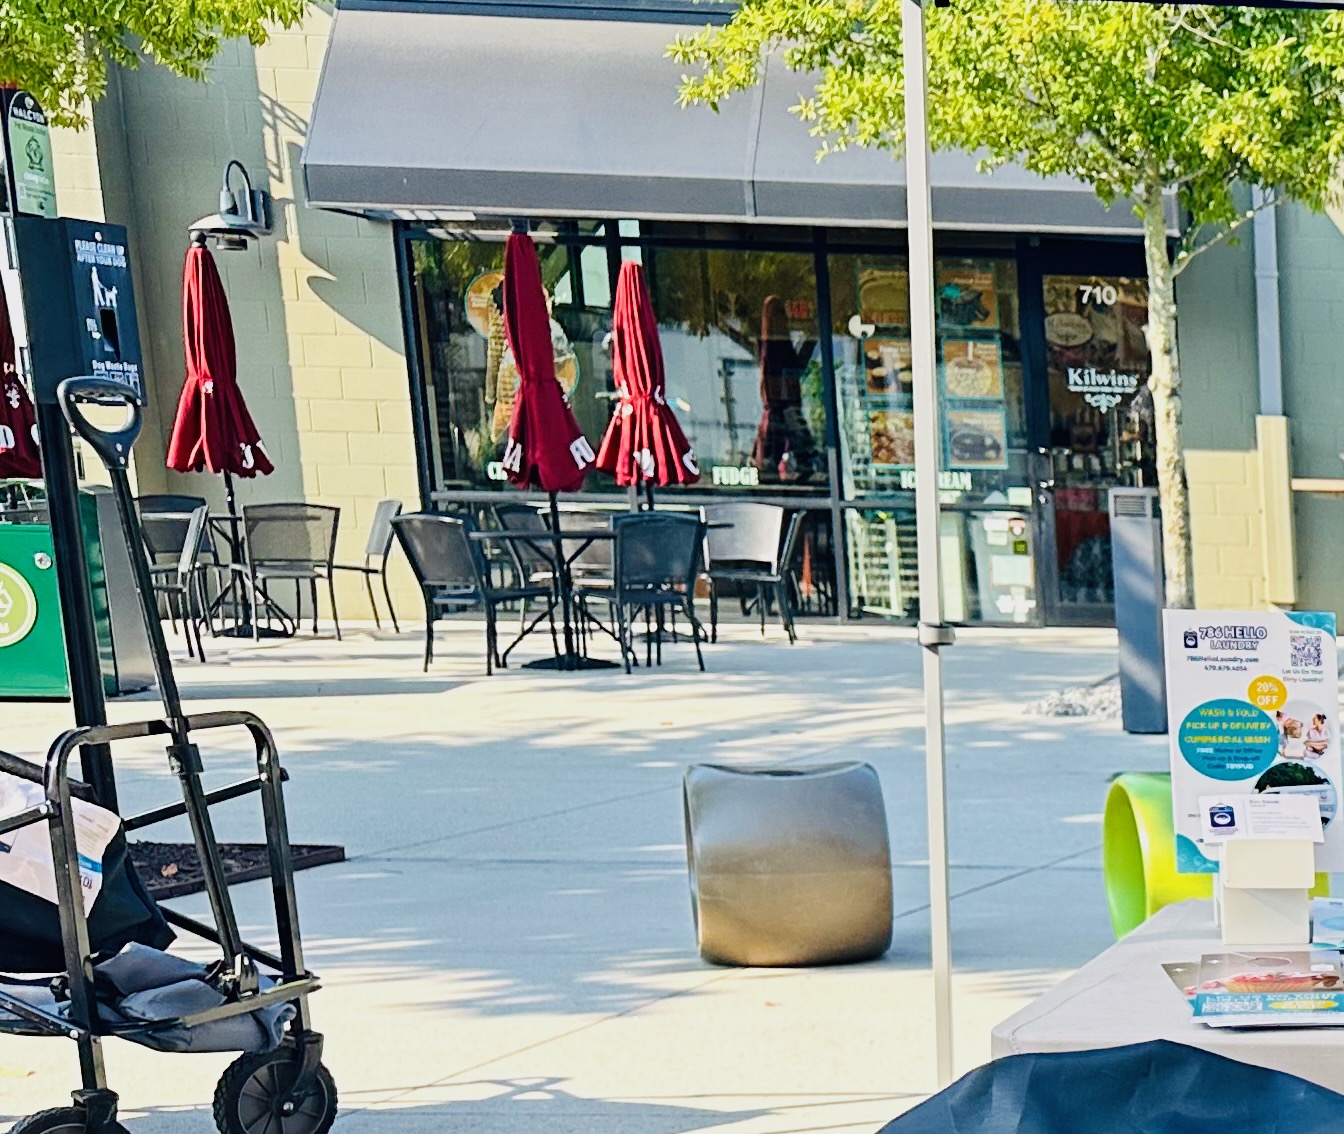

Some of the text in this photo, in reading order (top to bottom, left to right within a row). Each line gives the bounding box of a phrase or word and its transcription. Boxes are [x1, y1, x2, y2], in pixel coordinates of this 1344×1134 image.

[1079, 285, 1117, 305] 710
[1067, 367, 1140, 387] Kilwins
[712, 466, 760, 486] FUDGE
[1199, 626, 1268, 640] 786 HELLO
[1209, 640, 1260, 651] LAUNDRY
[1256, 682, 1279, 694] 20%
[1256, 695, 1279, 706] OFF
[1200, 708, 1225, 718] WASH
[1236, 708, 1259, 718] FOLD
[1186, 721, 1206, 730] PICK
[1207, 721, 1220, 730] UP
[1230, 721, 1271, 730] DELIVERY
